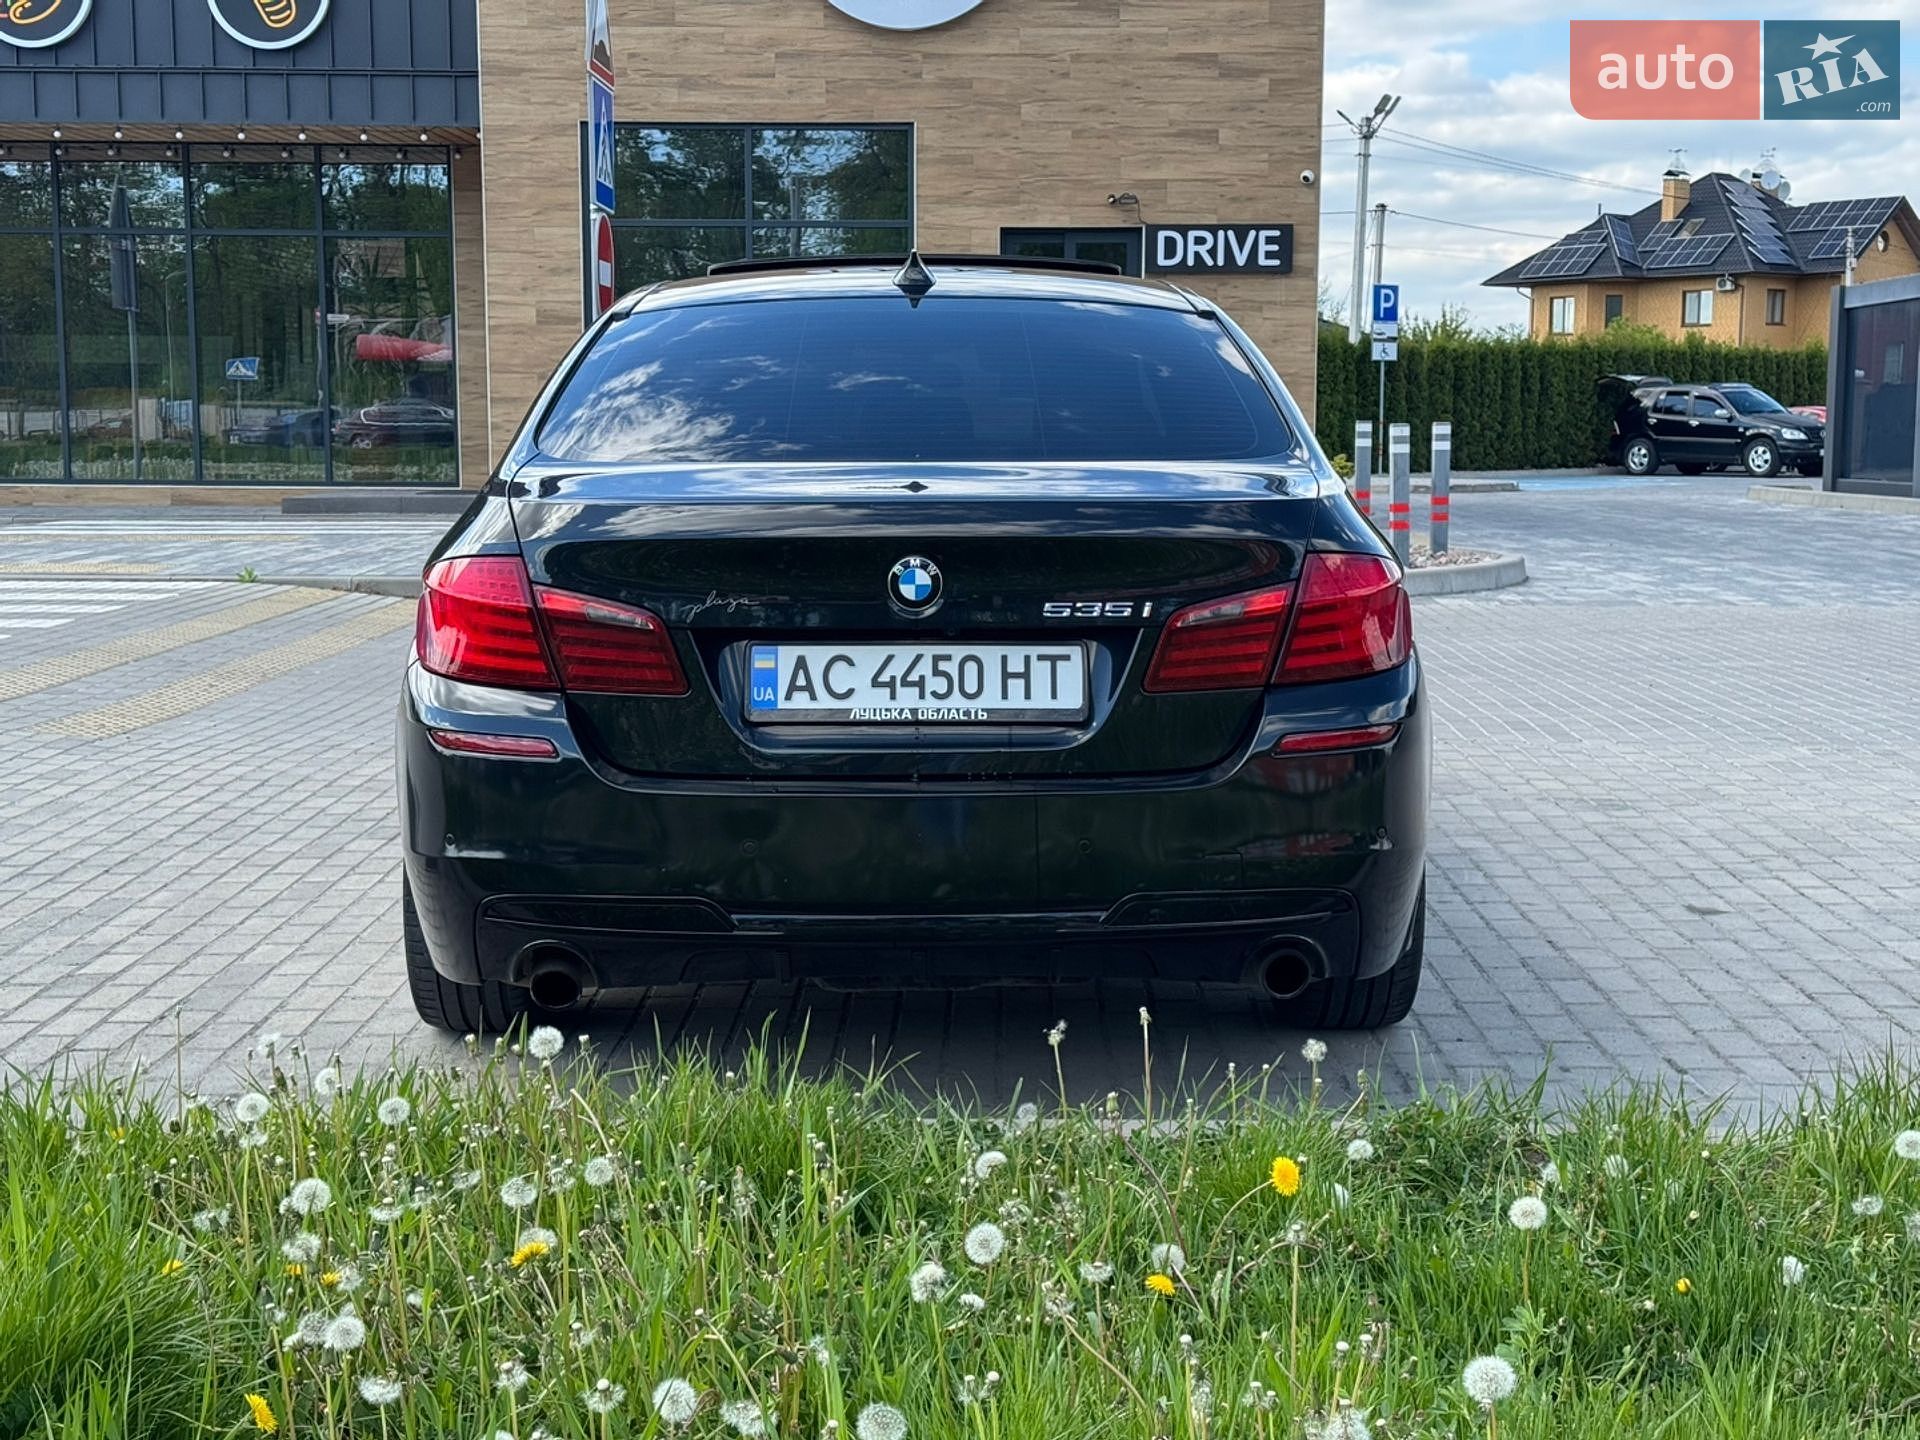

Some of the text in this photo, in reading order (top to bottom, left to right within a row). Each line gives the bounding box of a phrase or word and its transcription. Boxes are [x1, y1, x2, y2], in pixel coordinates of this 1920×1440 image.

[1157, 229, 1281, 267] DRIVE
[1380, 288, 1395, 318] P
[894, 558, 938, 576] BMW
[784, 654, 1071, 701] AC 4450 HT
[753, 686, 775, 701] UA
[849, 707, 988, 720] ЛУЦЬКА ОБЛАСТЬ
